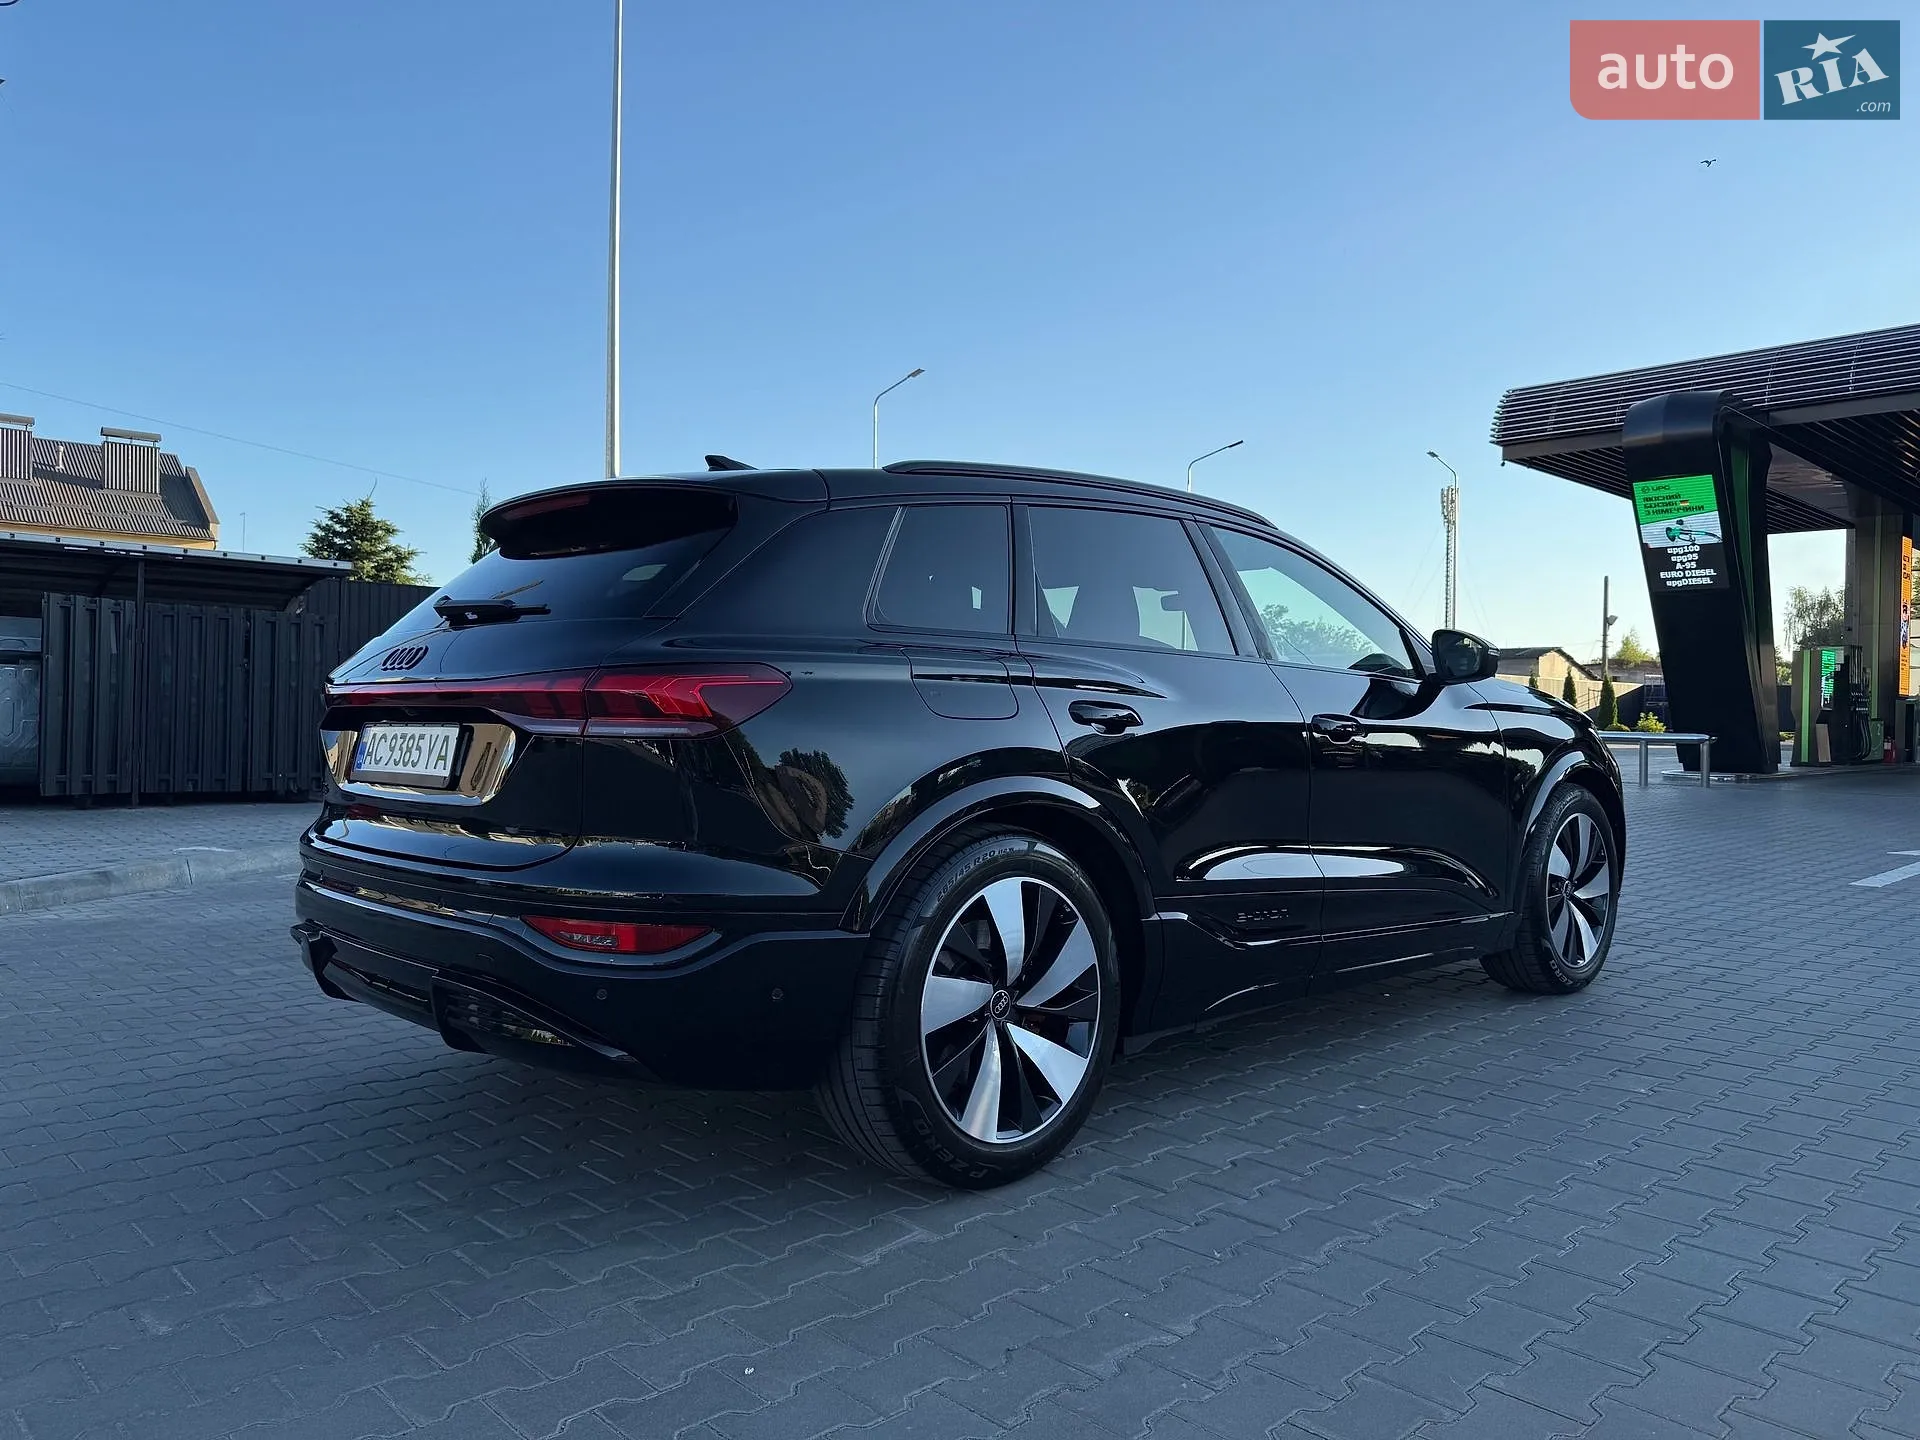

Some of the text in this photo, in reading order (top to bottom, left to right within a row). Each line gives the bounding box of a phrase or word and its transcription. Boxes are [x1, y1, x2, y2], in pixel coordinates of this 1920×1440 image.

[1660, 568, 1717, 579] EURO DIESEL
[385, 732, 426, 768] 9385
